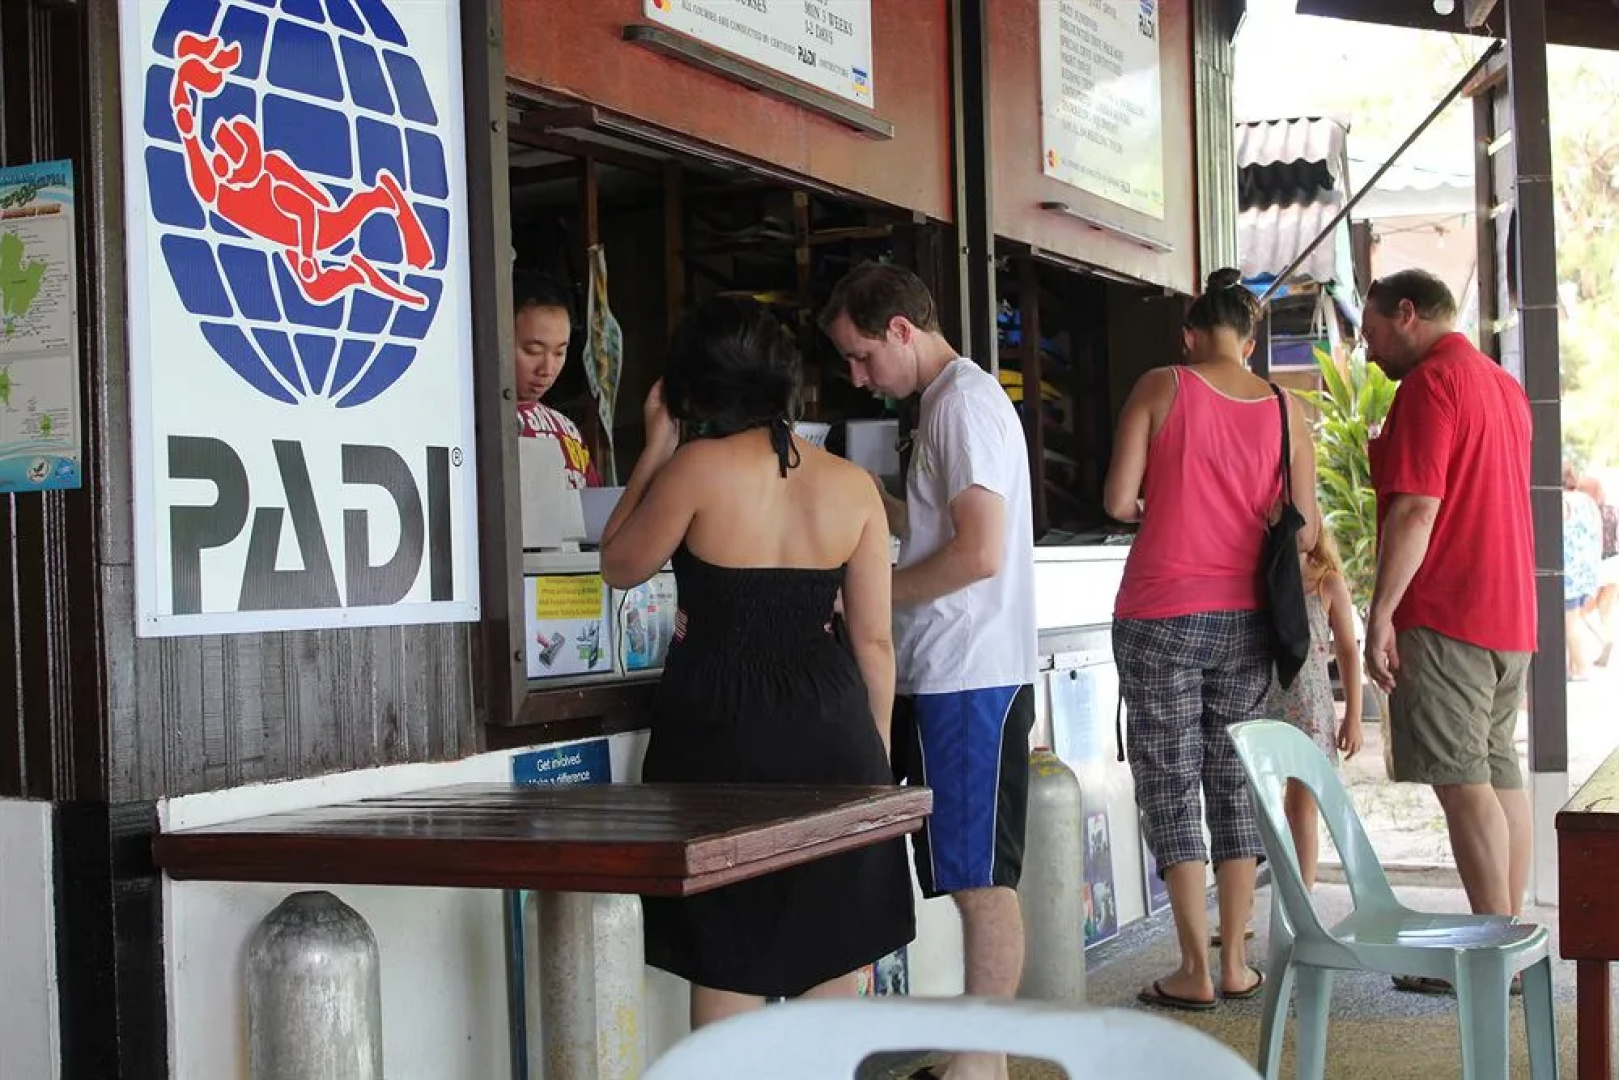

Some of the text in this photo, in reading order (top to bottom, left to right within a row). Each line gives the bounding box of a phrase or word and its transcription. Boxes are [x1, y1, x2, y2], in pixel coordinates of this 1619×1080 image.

[804, 1, 820, 19] MIN
[828, 12, 853, 37] WEEKS
[815, 23, 833, 45] DAYS
[730, 20, 762, 42] CONDUCTED
[797, 44, 817, 68] PADI
[167, 435, 454, 616] PADI
[537, 759, 551, 772] Get
